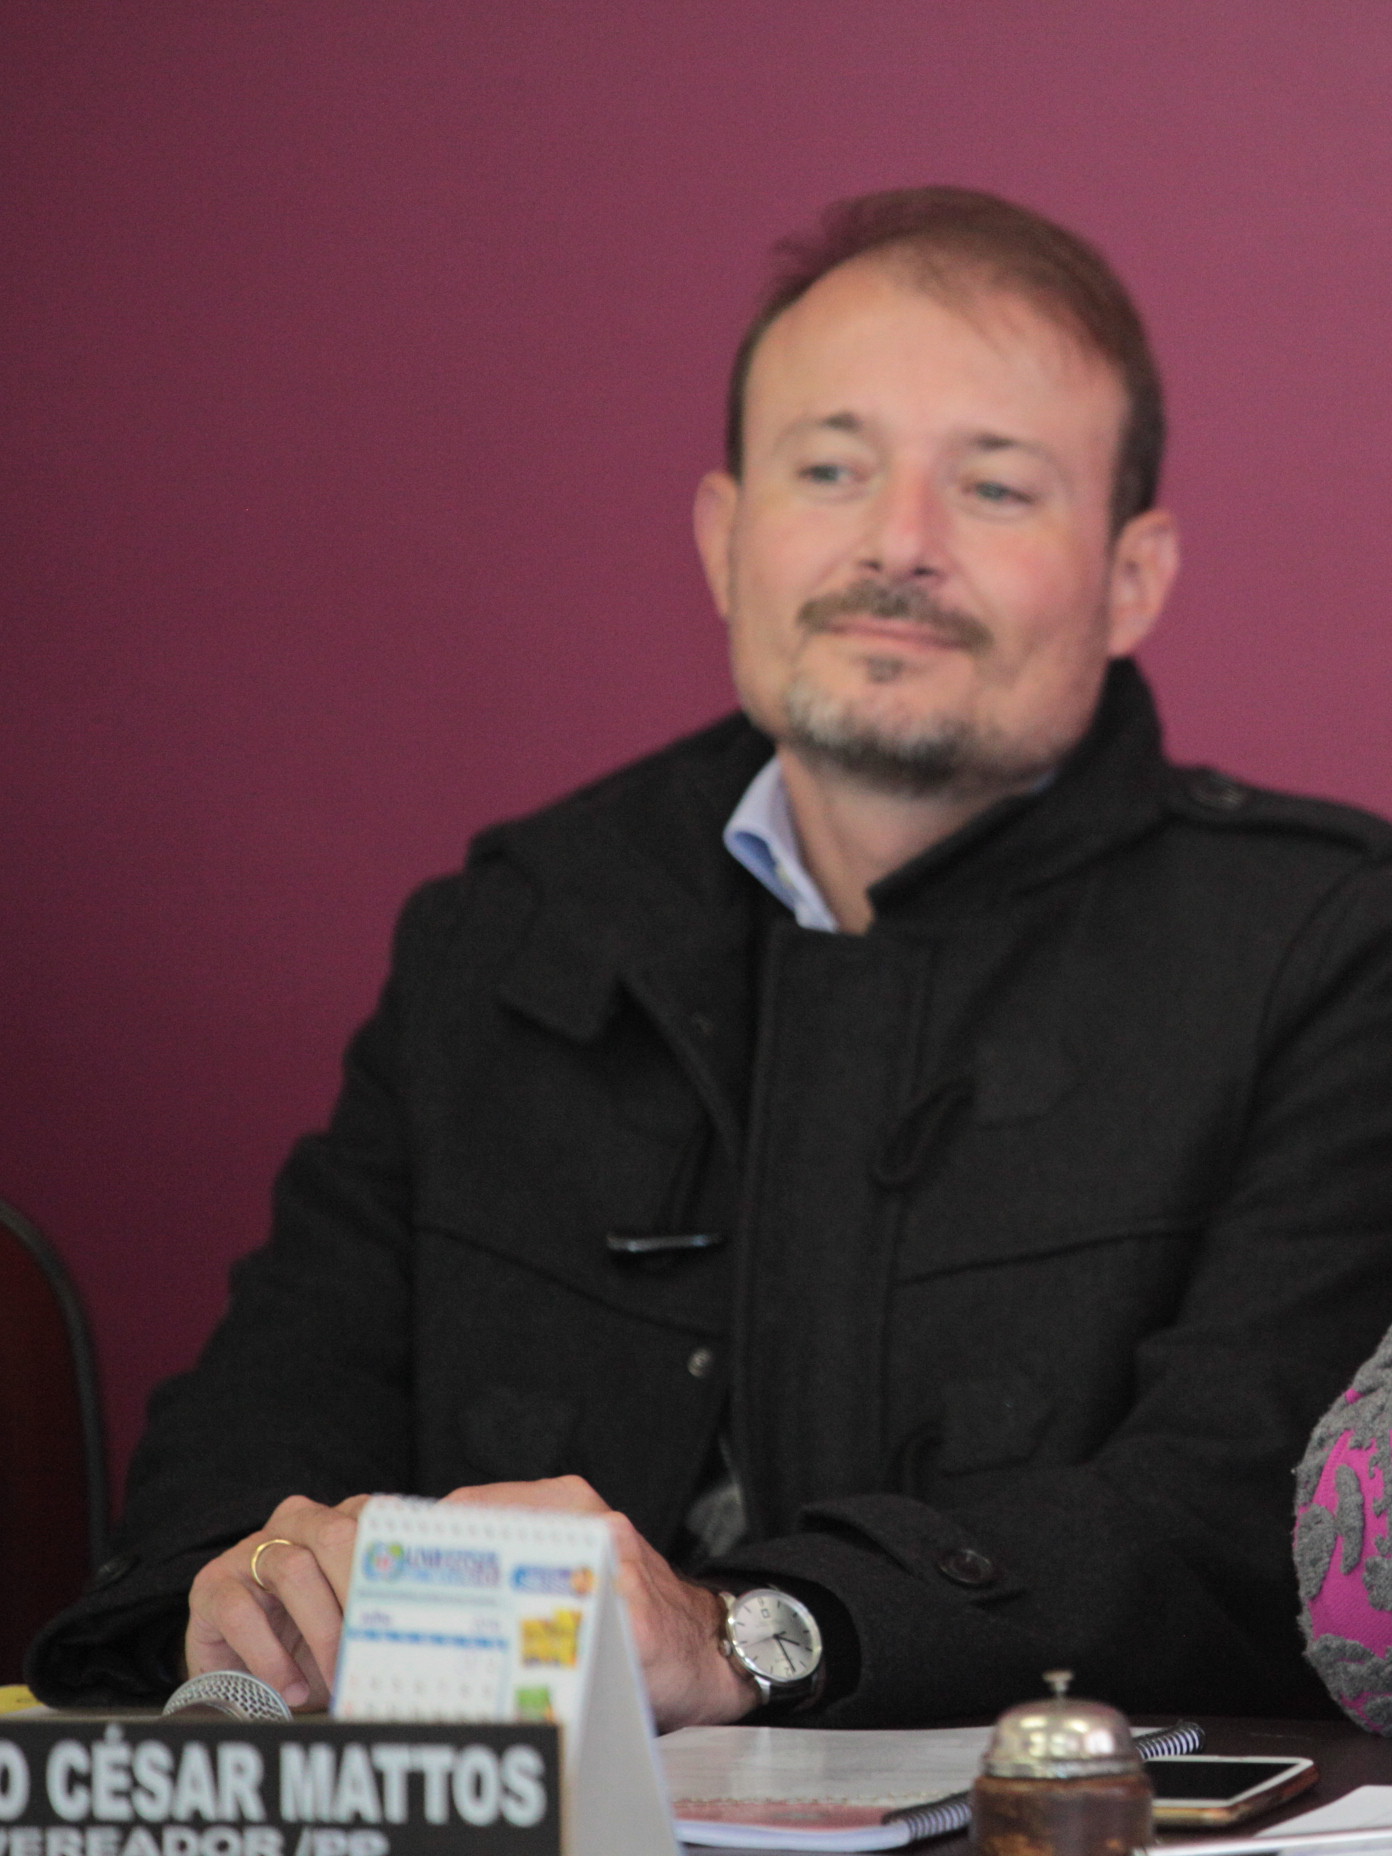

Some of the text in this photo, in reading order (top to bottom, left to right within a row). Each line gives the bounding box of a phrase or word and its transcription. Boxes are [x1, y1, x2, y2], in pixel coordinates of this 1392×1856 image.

[46, 1723, 267, 1823] CÉSAR
[279, 1741, 547, 1827] MATTOS
[0, 1825, 285, 1856] EREADOR
